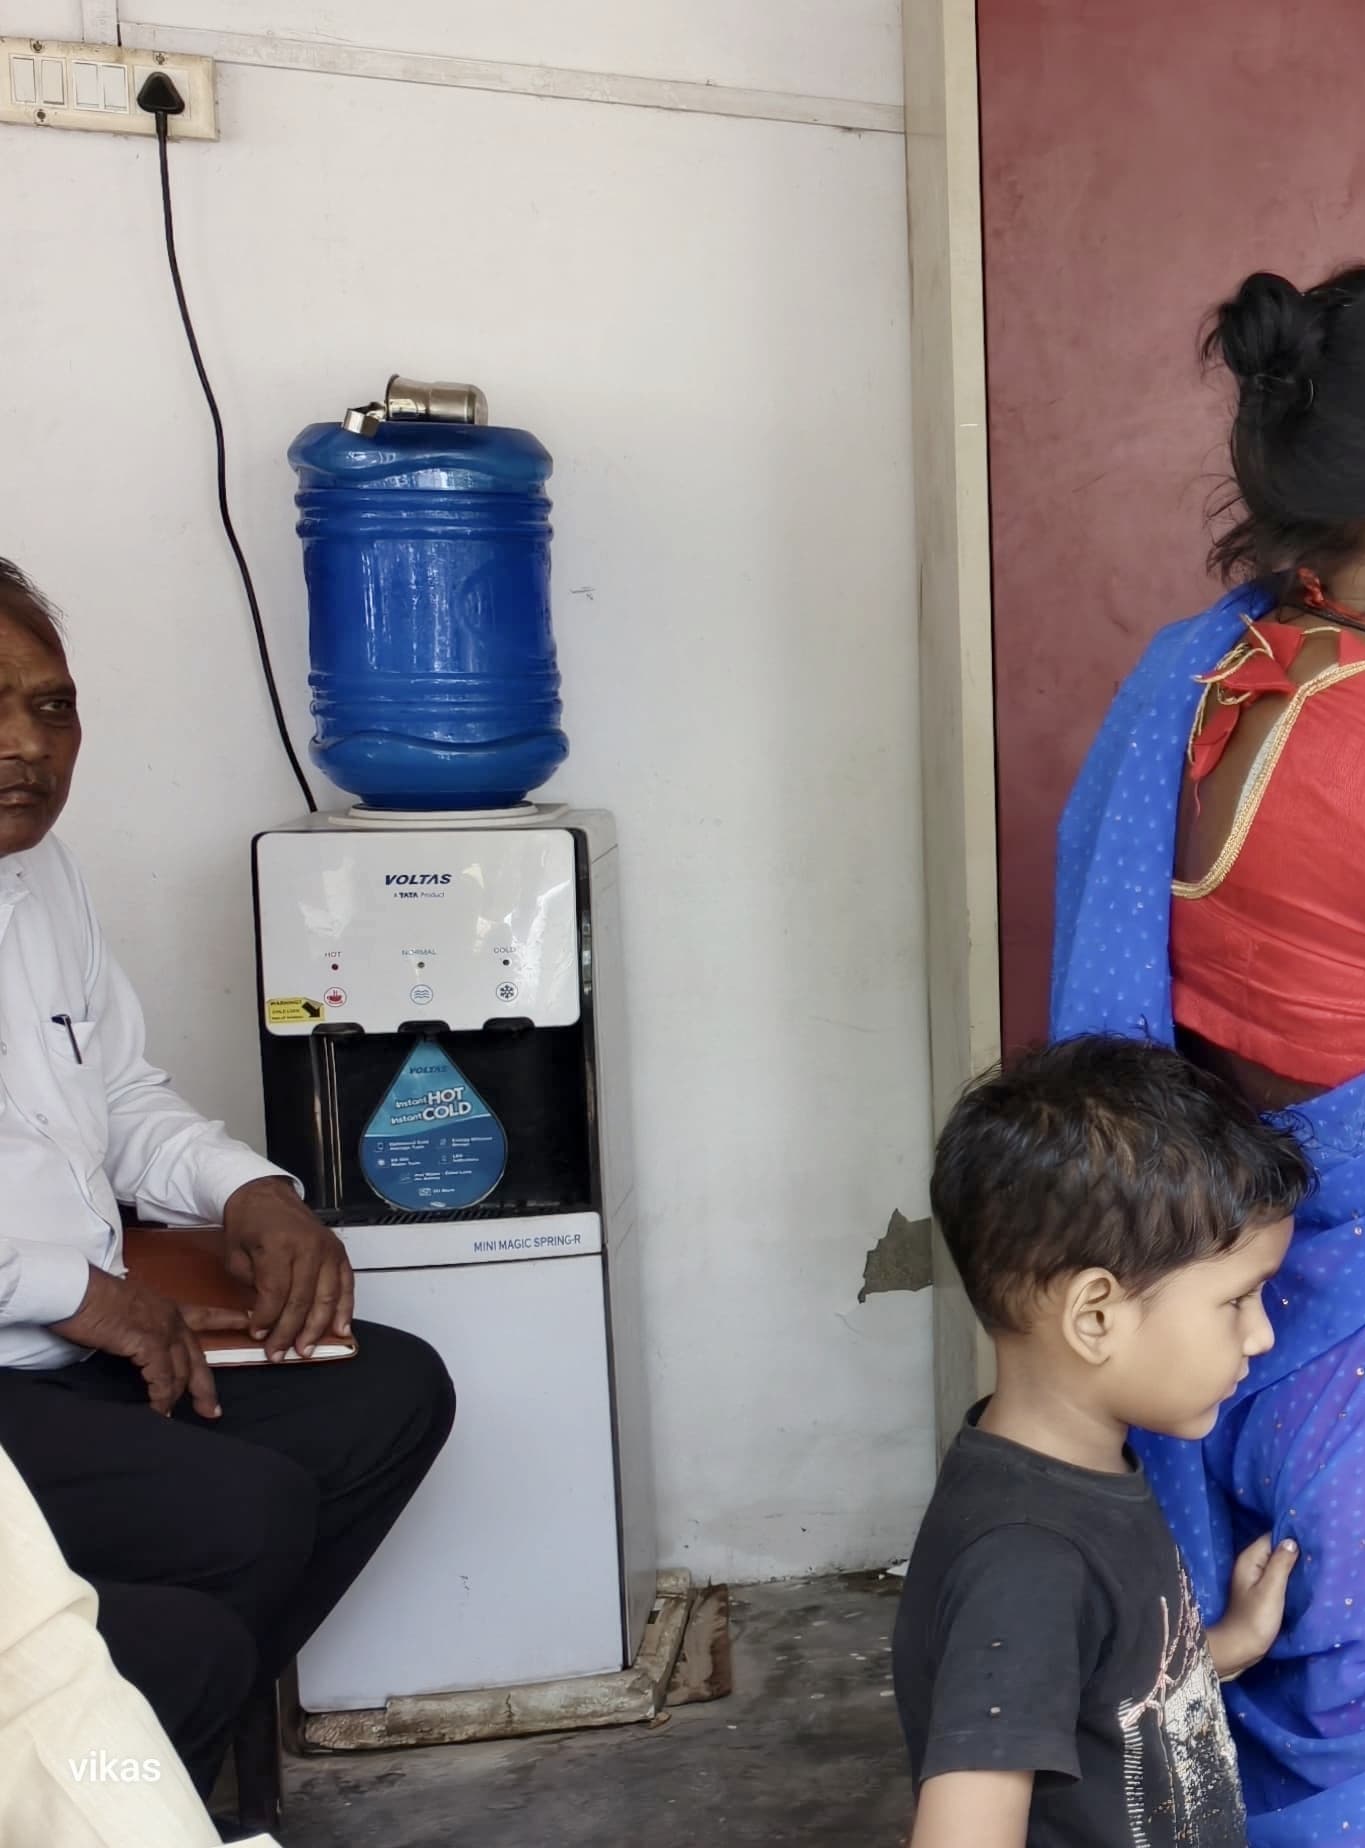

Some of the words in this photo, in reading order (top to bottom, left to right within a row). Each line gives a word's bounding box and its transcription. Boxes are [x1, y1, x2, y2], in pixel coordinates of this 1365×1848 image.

[385, 874, 453, 886] VOLTAS
[399, 891, 418, 899] TATA
[409, 1065, 448, 1075] VOLTAS
[396, 1096, 428, 1109] Instant
[428, 1087, 464, 1105] HOT
[391, 1112, 423, 1125] Instant
[423, 1102, 471, 1121] COLD
[473, 1241, 497, 1253] MINI
[499, 1238, 532, 1250] MAGIC
[534, 1234, 581, 1248] SPRING-R
